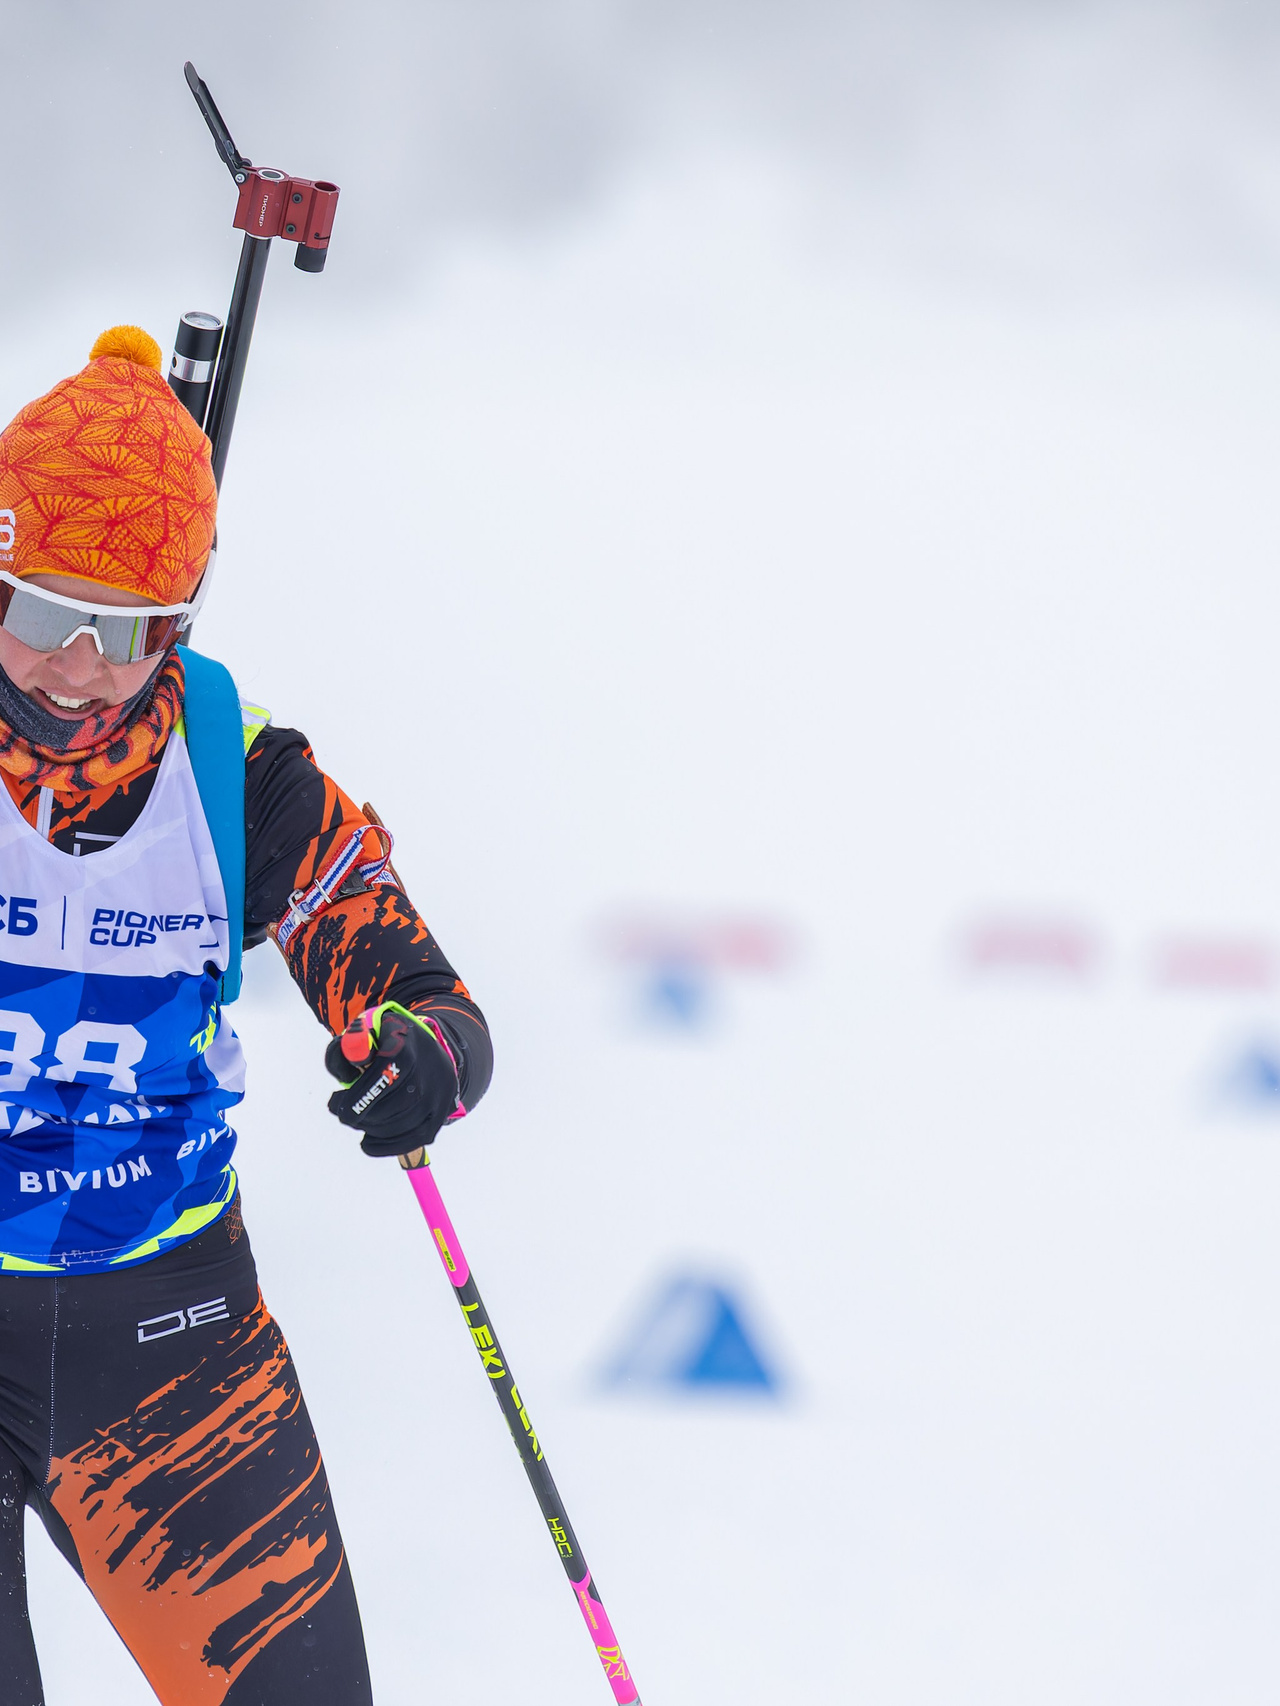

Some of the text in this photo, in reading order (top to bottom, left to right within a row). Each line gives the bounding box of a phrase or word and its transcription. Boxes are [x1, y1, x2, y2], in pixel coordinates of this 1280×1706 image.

[89, 928, 157, 947] CUP
[92, 908, 205, 932] PIONER
[19, 1155, 152, 1193] BIVIUM
[137, 1296, 231, 1344] DE
[461, 1302, 506, 1379] LEKI
[547, 1517, 572, 1555] HRC
